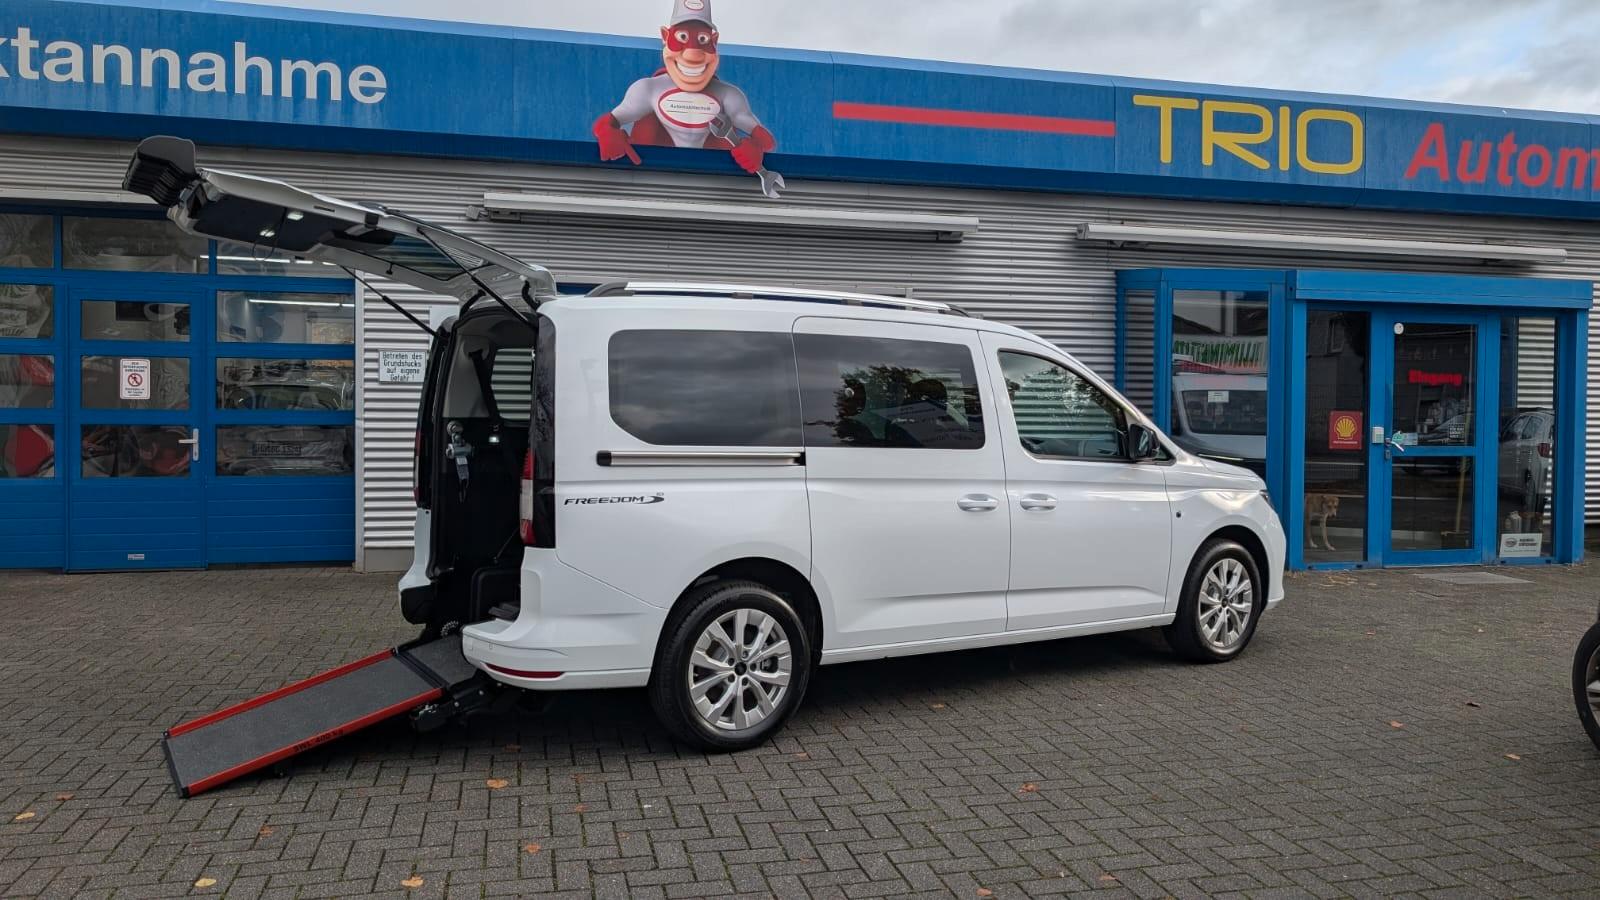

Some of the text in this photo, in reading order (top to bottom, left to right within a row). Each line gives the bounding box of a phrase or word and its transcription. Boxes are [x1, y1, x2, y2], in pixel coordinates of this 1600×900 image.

[1132, 94, 1364, 175] TRIO
[411, 352, 423, 360] des
[563, 495, 645, 505] FREEDOM
